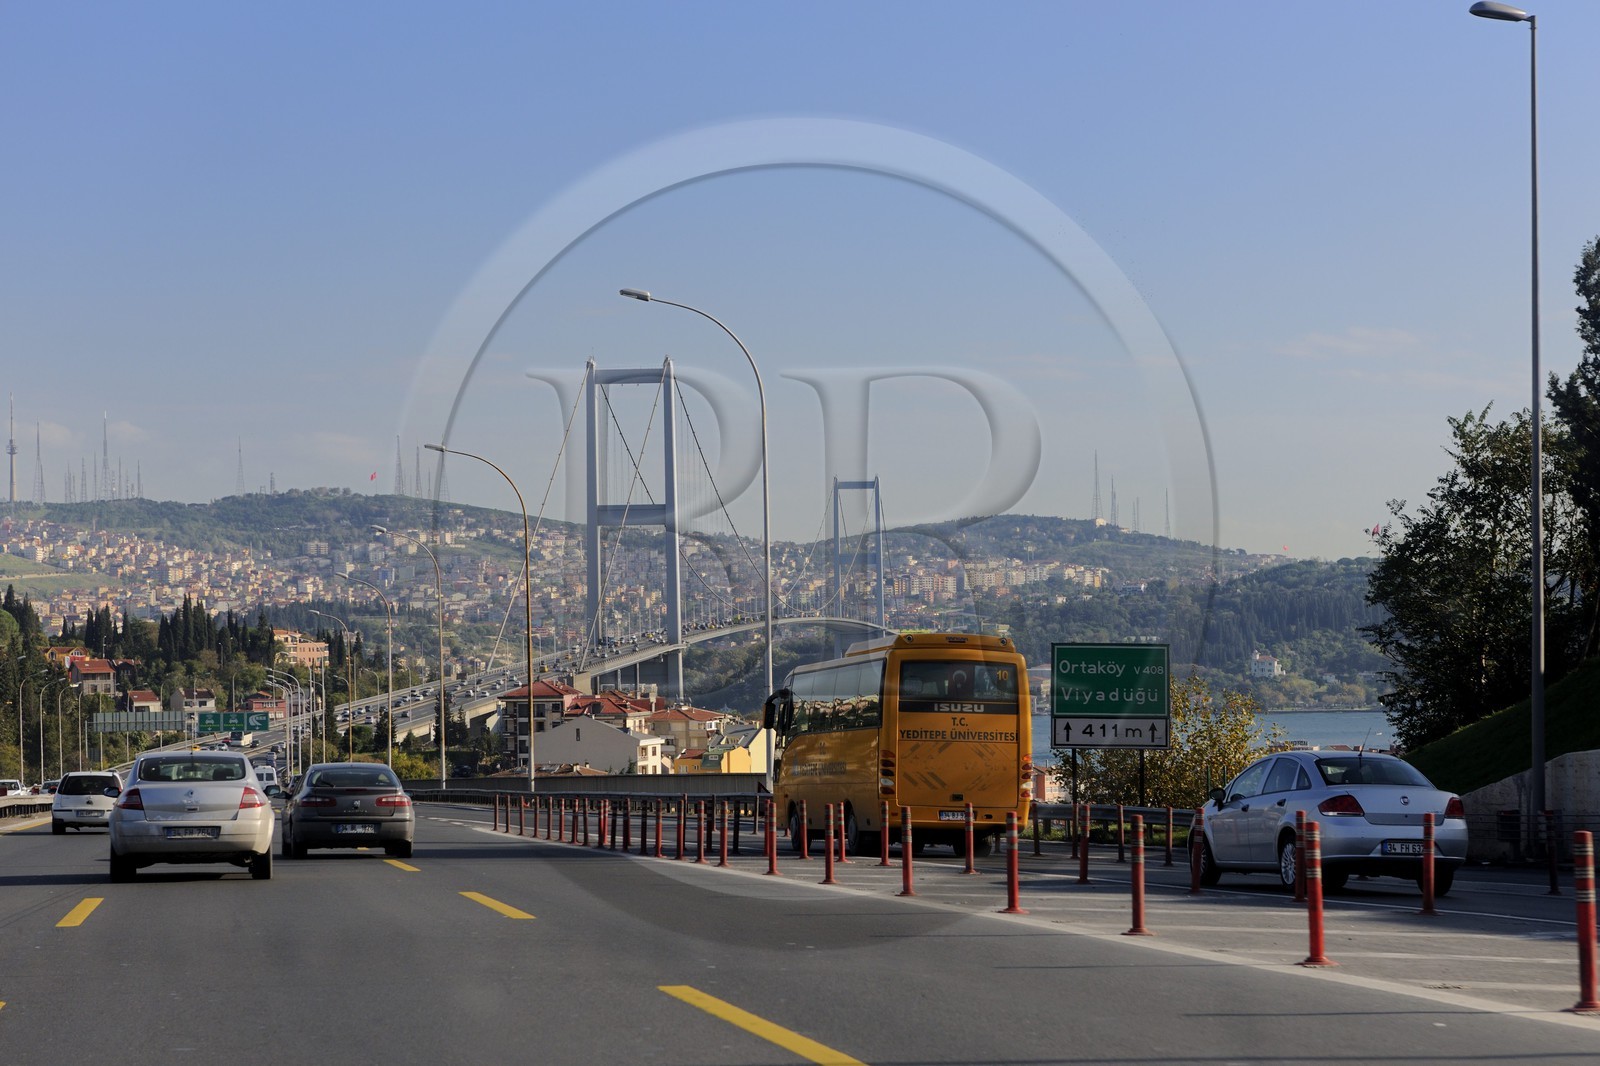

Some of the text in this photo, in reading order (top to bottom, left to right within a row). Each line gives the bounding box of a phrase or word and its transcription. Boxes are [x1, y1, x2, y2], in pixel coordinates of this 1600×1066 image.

[1059, 659, 1126, 677] Ortaköy
[996, 670, 1009, 681] 10
[1061, 687, 1158, 705] Viyadüğü
[933, 703, 985, 712] ISUZU
[951, 717, 969, 727] T.C.
[899, 728, 1019, 742] YEDİTEPE ÜNİVERSİTESİ
[1081, 723, 1142, 738] 411 m
[1387, 843, 1397, 852] 34
[1400, 843, 1410, 853] FH
